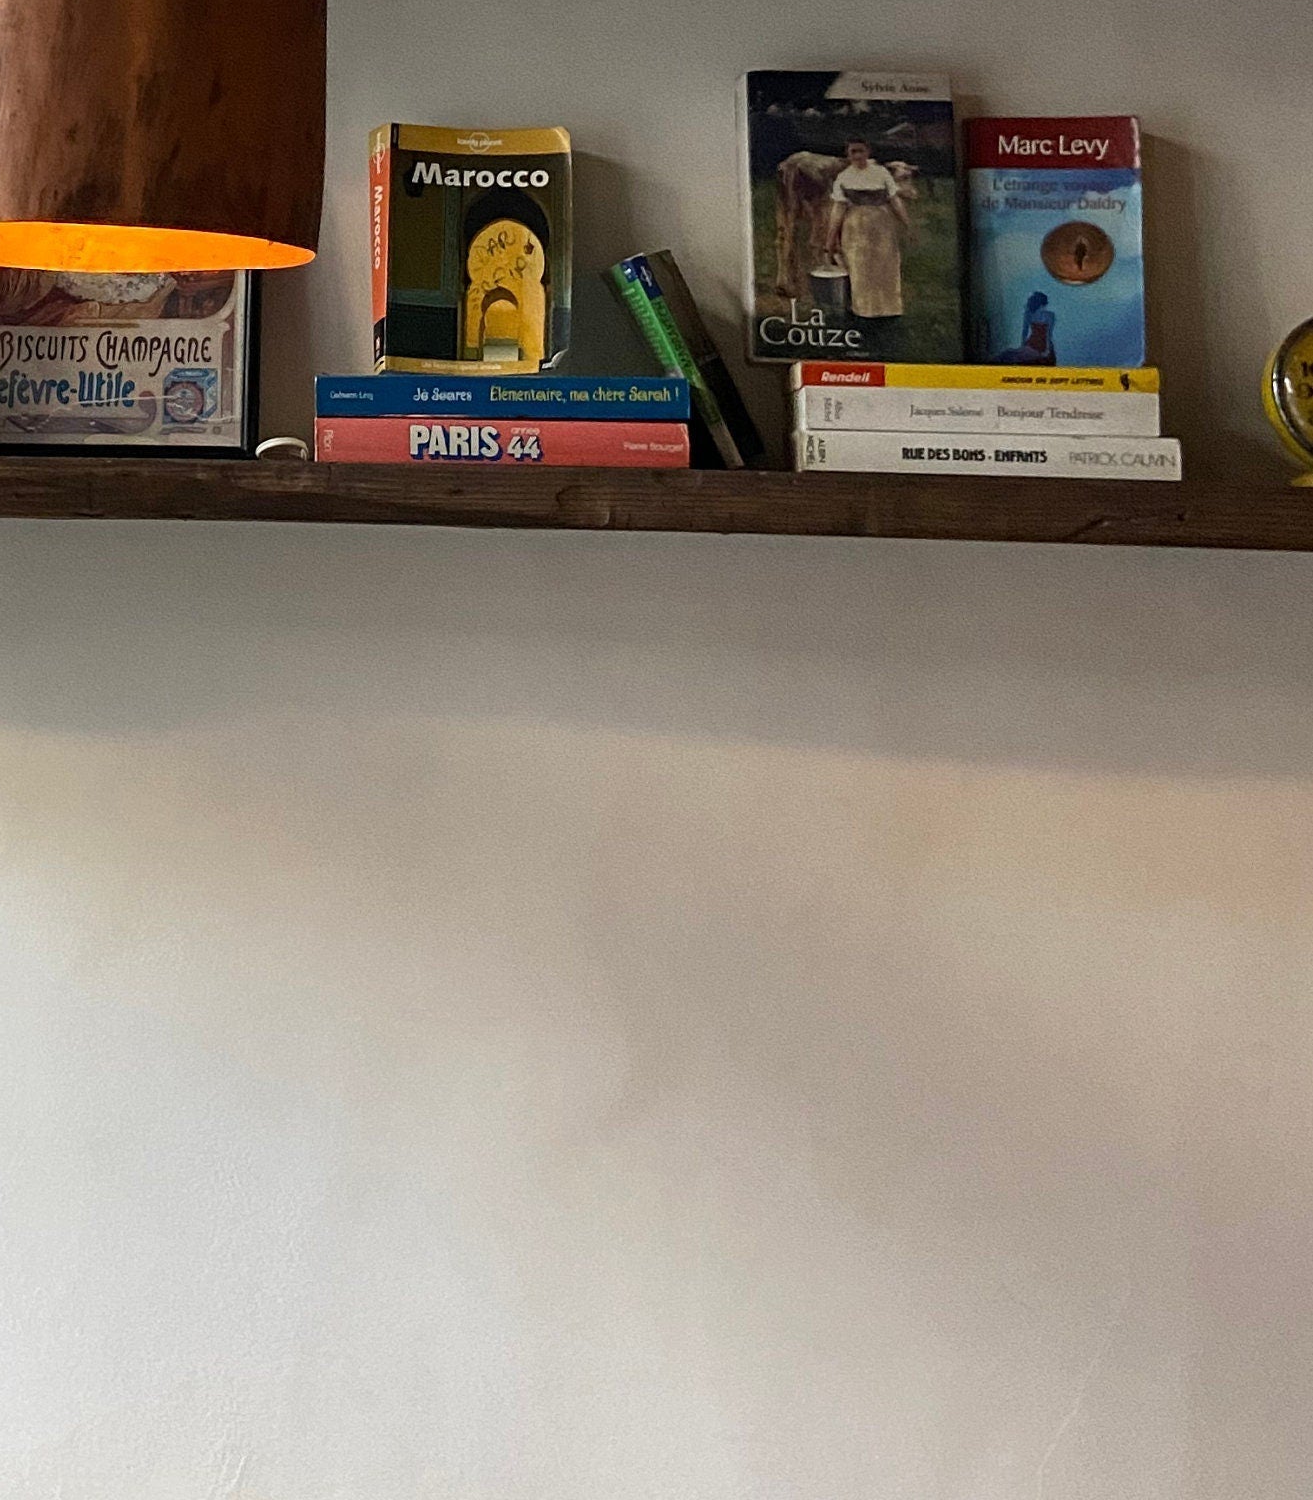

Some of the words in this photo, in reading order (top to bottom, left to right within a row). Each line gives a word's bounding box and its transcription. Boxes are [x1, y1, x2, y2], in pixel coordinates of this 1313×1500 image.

[861, 81, 896, 95] Sylvie
[998, 134, 1053, 156] Marc
[1059, 134, 1110, 161] Levy
[411, 161, 550, 188] Marocco
[1077, 196, 1126, 214] Daldry
[373, 185, 384, 270] Marocco
[790, 298, 826, 327] La
[759, 316, 862, 348] Couze
[0, 331, 89, 370] BISCUITS
[96, 330, 213, 377] CHAMPAGNE
[821, 370, 871, 383] Rendell
[431, 387, 472, 402] Soares
[569, 390, 590, 402] ma
[592, 387, 626, 403] chère
[628, 386, 671, 403] Sarah
[909, 404, 948, 419] Jacques
[997, 405, 1045, 420] Bonjour
[1048, 407, 1104, 421] Tendresse
[408, 424, 501, 460] PARIS
[506, 436, 543, 461] 44
[901, 447, 926, 461] RUE
[928, 447, 951, 461] DES
[952, 447, 987, 462] BONS
[994, 449, 1048, 464] ENFANTS
[1069, 451, 1118, 466] PATRICK
[1119, 453, 1177, 468] CAUVIN
